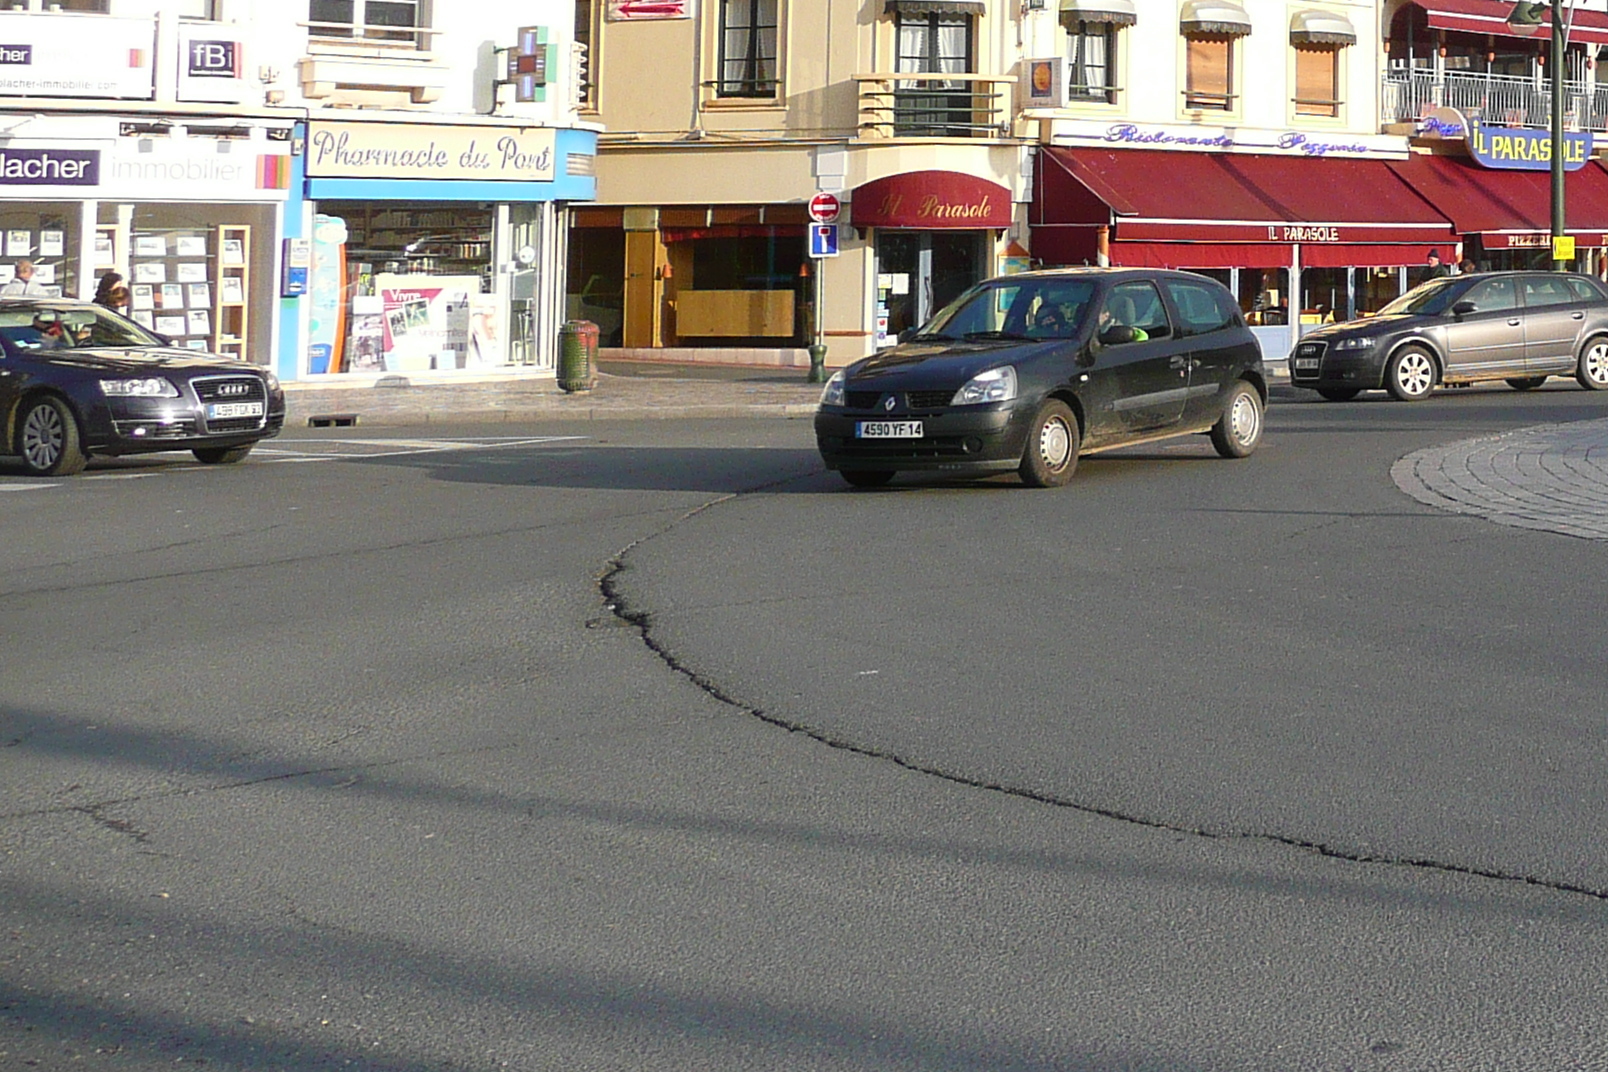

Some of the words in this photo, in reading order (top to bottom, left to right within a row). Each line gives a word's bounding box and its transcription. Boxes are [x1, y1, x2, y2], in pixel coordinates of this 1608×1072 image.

[0, 47, 28, 62] her
[1104, 124, 1233, 147] Ristorante
[1277, 132, 1366, 156] Pizzeria
[313, 130, 449, 168] Pharmacie
[459, 140, 491, 169] du
[497, 136, 552, 171] Pont
[112, 157, 242, 181] immobilier
[917, 193, 992, 219] Parasole
[1268, 226, 1278, 240] IL
[1284, 227, 1339, 241] PARASOLE
[1508, 235, 1554, 246] PIZZERI
[864, 423, 890, 436] 4590
[892, 423, 905, 436] YF
[908, 423, 921, 436] 14
